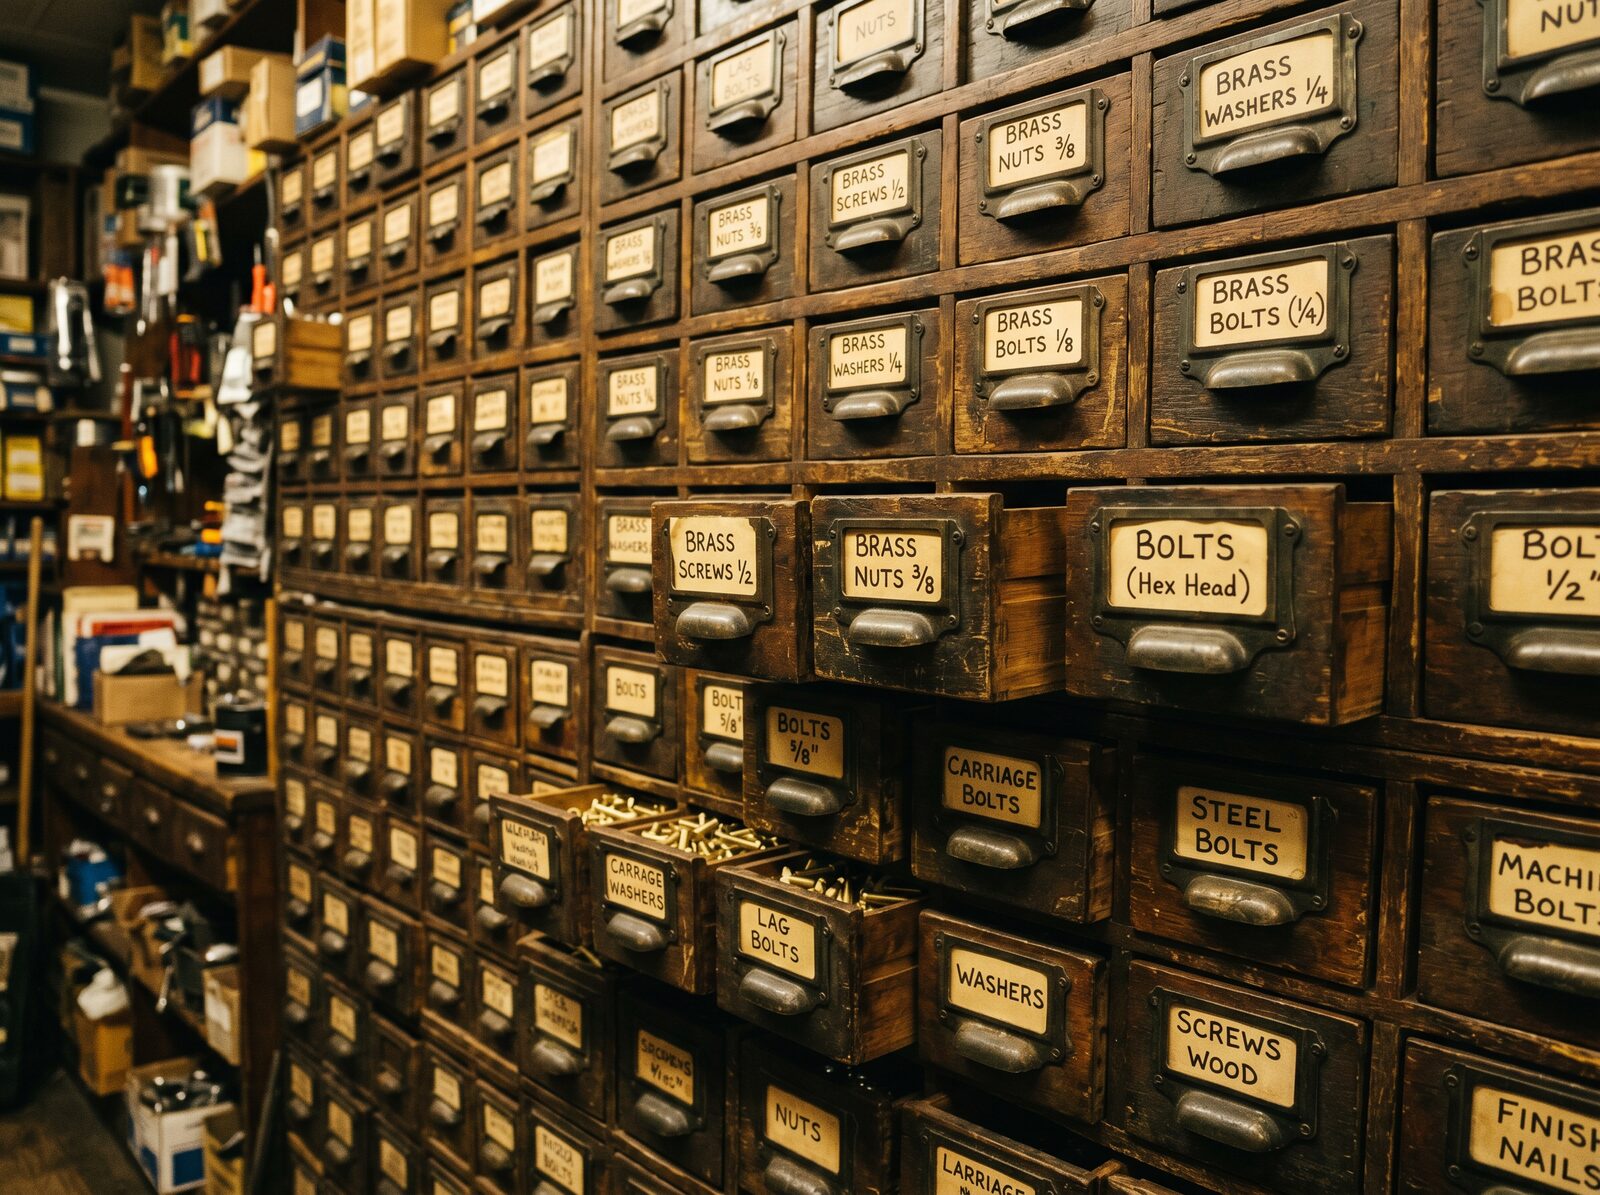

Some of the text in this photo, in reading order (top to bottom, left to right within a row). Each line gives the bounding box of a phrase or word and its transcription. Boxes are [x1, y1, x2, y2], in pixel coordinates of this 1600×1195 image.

[855, 10, 896, 42] NUTS
[728, 57, 752, 78] LAG
[1216, 55, 1292, 96] BRASS
[723, 73, 761, 100] BOLTS
[1205, 87, 1297, 128] WASHERS
[1006, 113, 1062, 145] BRASS
[999, 144, 1045, 173] NUTS
[842, 164, 885, 190] BRASS
[836, 185, 888, 212] SCREWS
[719, 206, 753, 229] BRASS
[615, 234, 643, 255] BRASS
[716, 229, 744, 248] NUTS
[1213, 274, 1289, 304] BRASS
[1517, 278, 1600, 312] BOLT
[997, 308, 1053, 333] BRASS
[1210, 307, 1280, 335] BOLTS
[842, 333, 885, 354] BRASS
[996, 335, 1046, 358] BOLTS
[716, 355, 750, 372] BRASS
[834, 358, 885, 377] WASHERS
[617, 372, 646, 389] BRASS
[713, 376, 741, 392] NUTS
[616, 392, 641, 407] NUTS
[616, 516, 647, 534] BRASS
[685, 530, 735, 553] BRASS
[856, 533, 917, 557] BRASS
[1136, 528, 1235, 560] BOLTS
[679, 560, 733, 581] SCREWS
[854, 566, 904, 589] NUTS
[1126, 566, 1250, 605] (Hex Head)
[615, 678, 646, 699] BOLTS
[777, 712, 831, 741] BOLTS
[947, 755, 1037, 791] CARRIAGE
[962, 783, 1020, 815] BOLTS
[1191, 796, 1282, 833] STEEL
[1195, 828, 1279, 866] BOLTS
[610, 858, 663, 888] CARRAGE
[1498, 852, 1600, 892] MACHI
[610, 879, 664, 911] WASHERS
[1514, 888, 1600, 926] BOLT
[757, 907, 790, 935] LAG
[751, 931, 800, 963] BOLTS
[956, 963, 1044, 1010] WASHERS
[1177, 1010, 1281, 1061] SCREWS
[1187, 1045, 1258, 1086] WOOD
[775, 1103, 821, 1142] NUTS
[1499, 1135, 1600, 1190] NAILS
